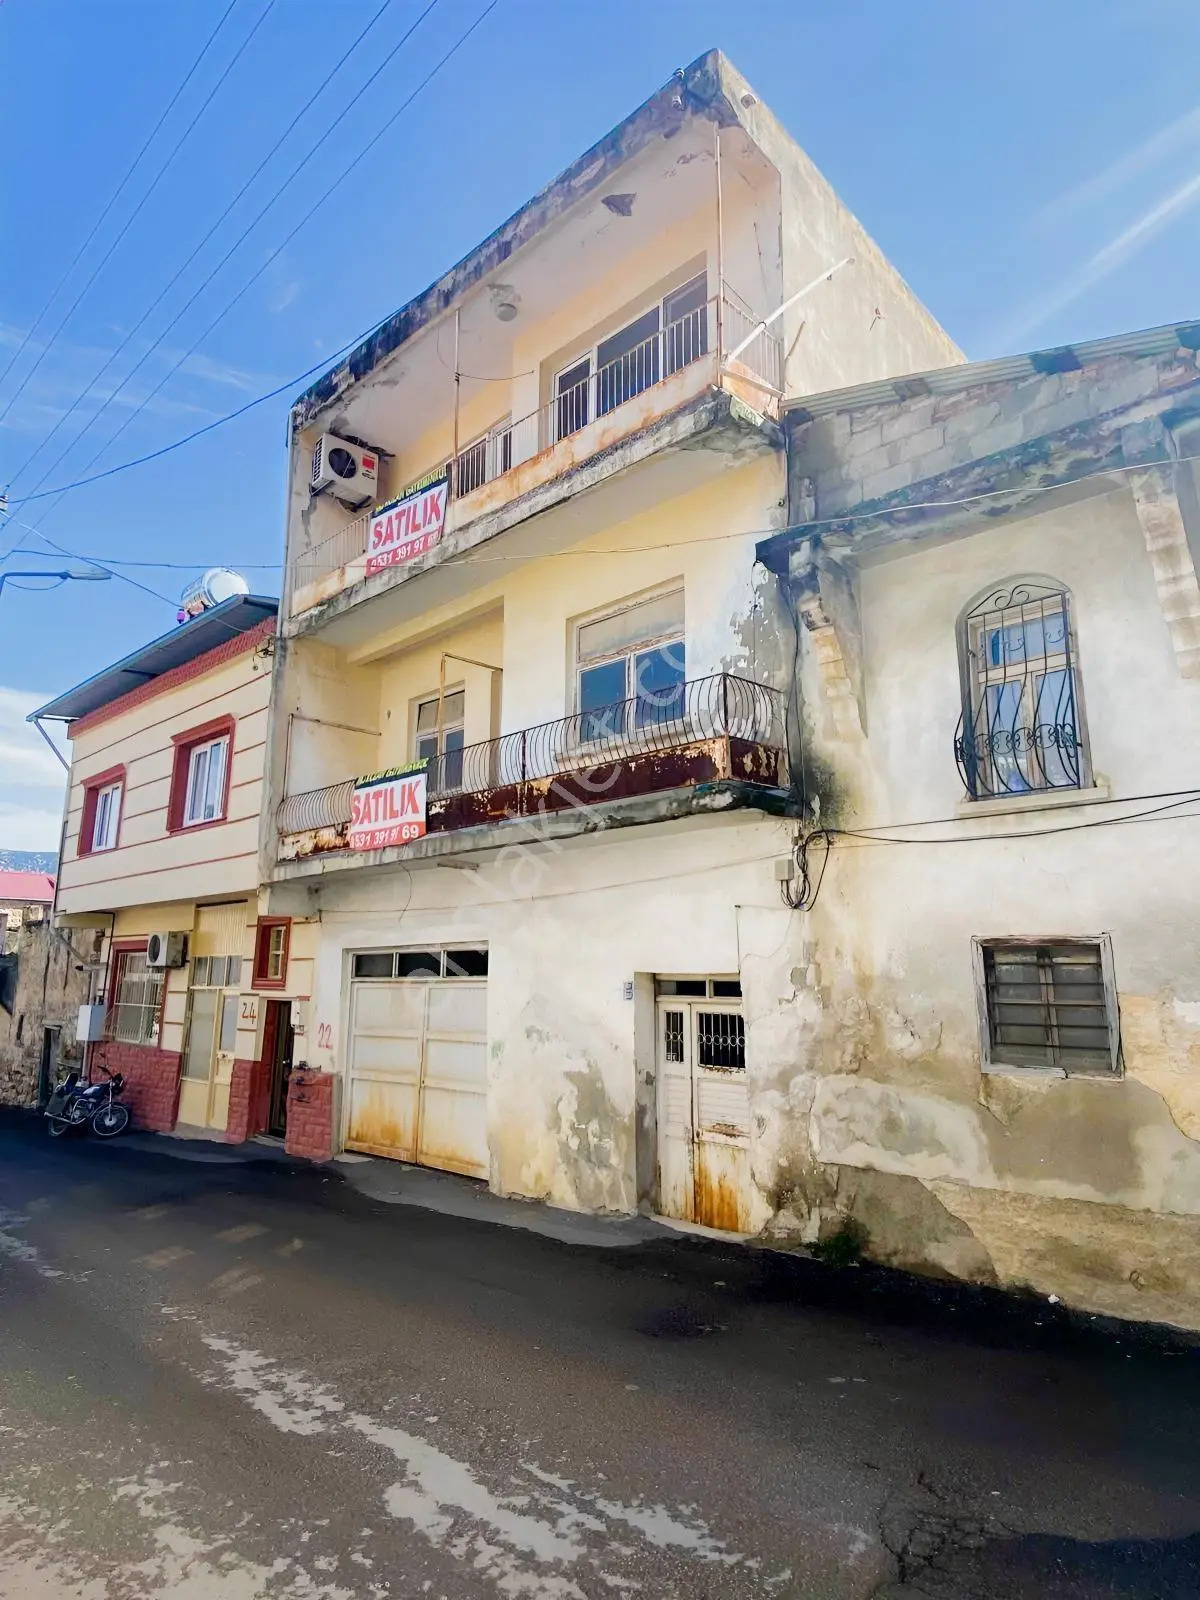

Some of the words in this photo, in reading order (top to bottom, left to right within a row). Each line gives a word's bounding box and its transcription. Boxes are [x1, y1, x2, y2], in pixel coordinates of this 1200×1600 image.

[372, 489, 444, 550] SATILIK
[351, 780, 421, 826] SATILIK
[401, 824, 419, 839] 69
[241, 1002, 257, 1025] 24
[318, 1022, 333, 1050] 22
